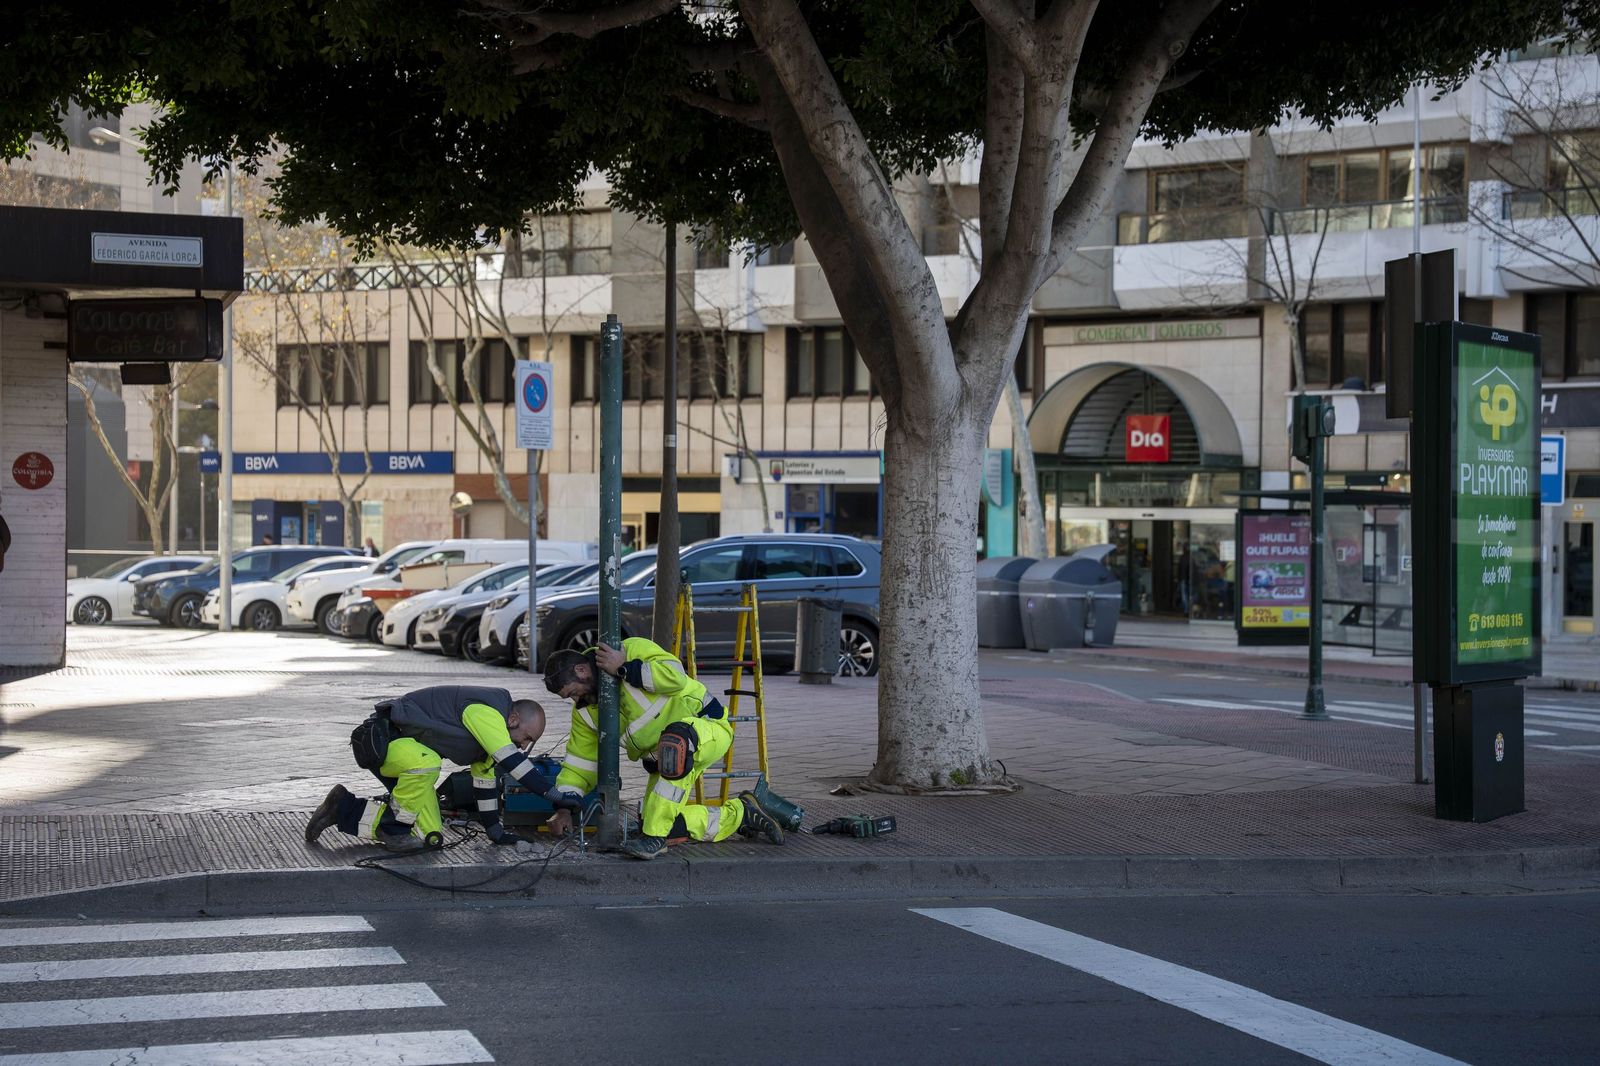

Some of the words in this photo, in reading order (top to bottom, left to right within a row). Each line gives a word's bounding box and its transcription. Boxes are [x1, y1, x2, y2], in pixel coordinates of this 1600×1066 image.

[128, 239, 168, 248] AVENIDA
[97, 248, 137, 260] FEDERICO
[139, 249, 169, 261] GARCÍA
[171, 251, 197, 262] LORCA
[1076, 325, 1149, 342] COMERCIAL
[1158, 321, 1223, 339] OLIVEROS
[202, 458, 218, 466] BBVA
[245, 455, 279, 471] BBVA
[389, 454, 425, 470] BBVA
[1460, 463, 1528, 497] PLAYMAR
[1246, 546, 1269, 556] QUE
[1270, 546, 1309, 556] FLIPAS!
[1481, 540, 1488, 560] de
[1488, 540, 1513, 560] confianza
[1482, 565, 1496, 587] desde
[1245, 615, 1279, 624] GRATIS
[1480, 615, 1495, 629] 613
[1496, 614, 1510, 628] 069
[1511, 613, 1523, 627] 115
